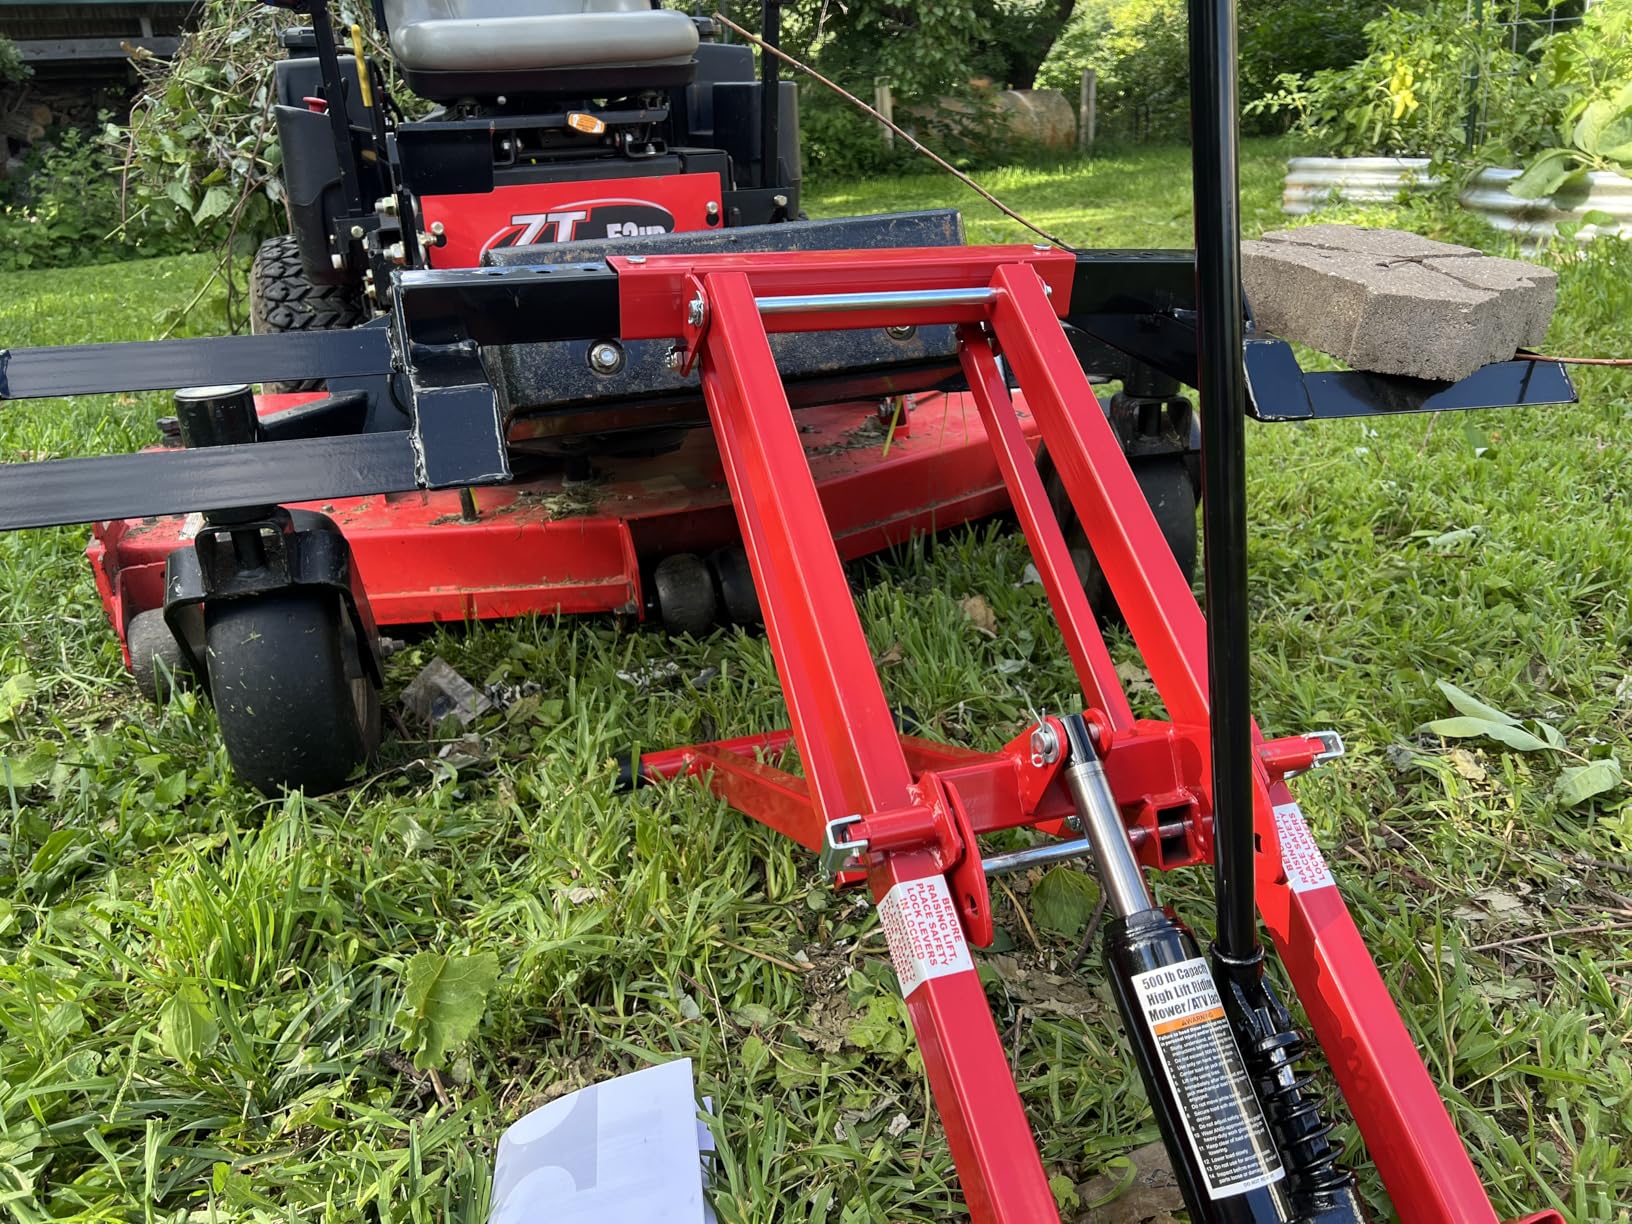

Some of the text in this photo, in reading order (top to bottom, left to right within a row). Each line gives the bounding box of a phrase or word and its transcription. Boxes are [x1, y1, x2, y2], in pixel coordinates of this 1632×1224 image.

[1280, 813, 1318, 884] PLACE SAFETY
[1285, 842, 1308, 883] RAISING
[1289, 813, 1325, 880] LOCK LEVERS
[900, 898, 925, 960] IN LOCKED
[907, 888, 937, 966] LOCK LEVERS
[916, 883, 949, 965] PLACE SAFETY
[927, 884, 957, 961] RAISING LIFT,
[941, 898, 961, 942] BEFORE
[1142, 963, 1208, 990] 500 lb Capacity
[1146, 980, 1214, 1006] High Lift Riding
[1149, 994, 1209, 1022] Mower/ATV
